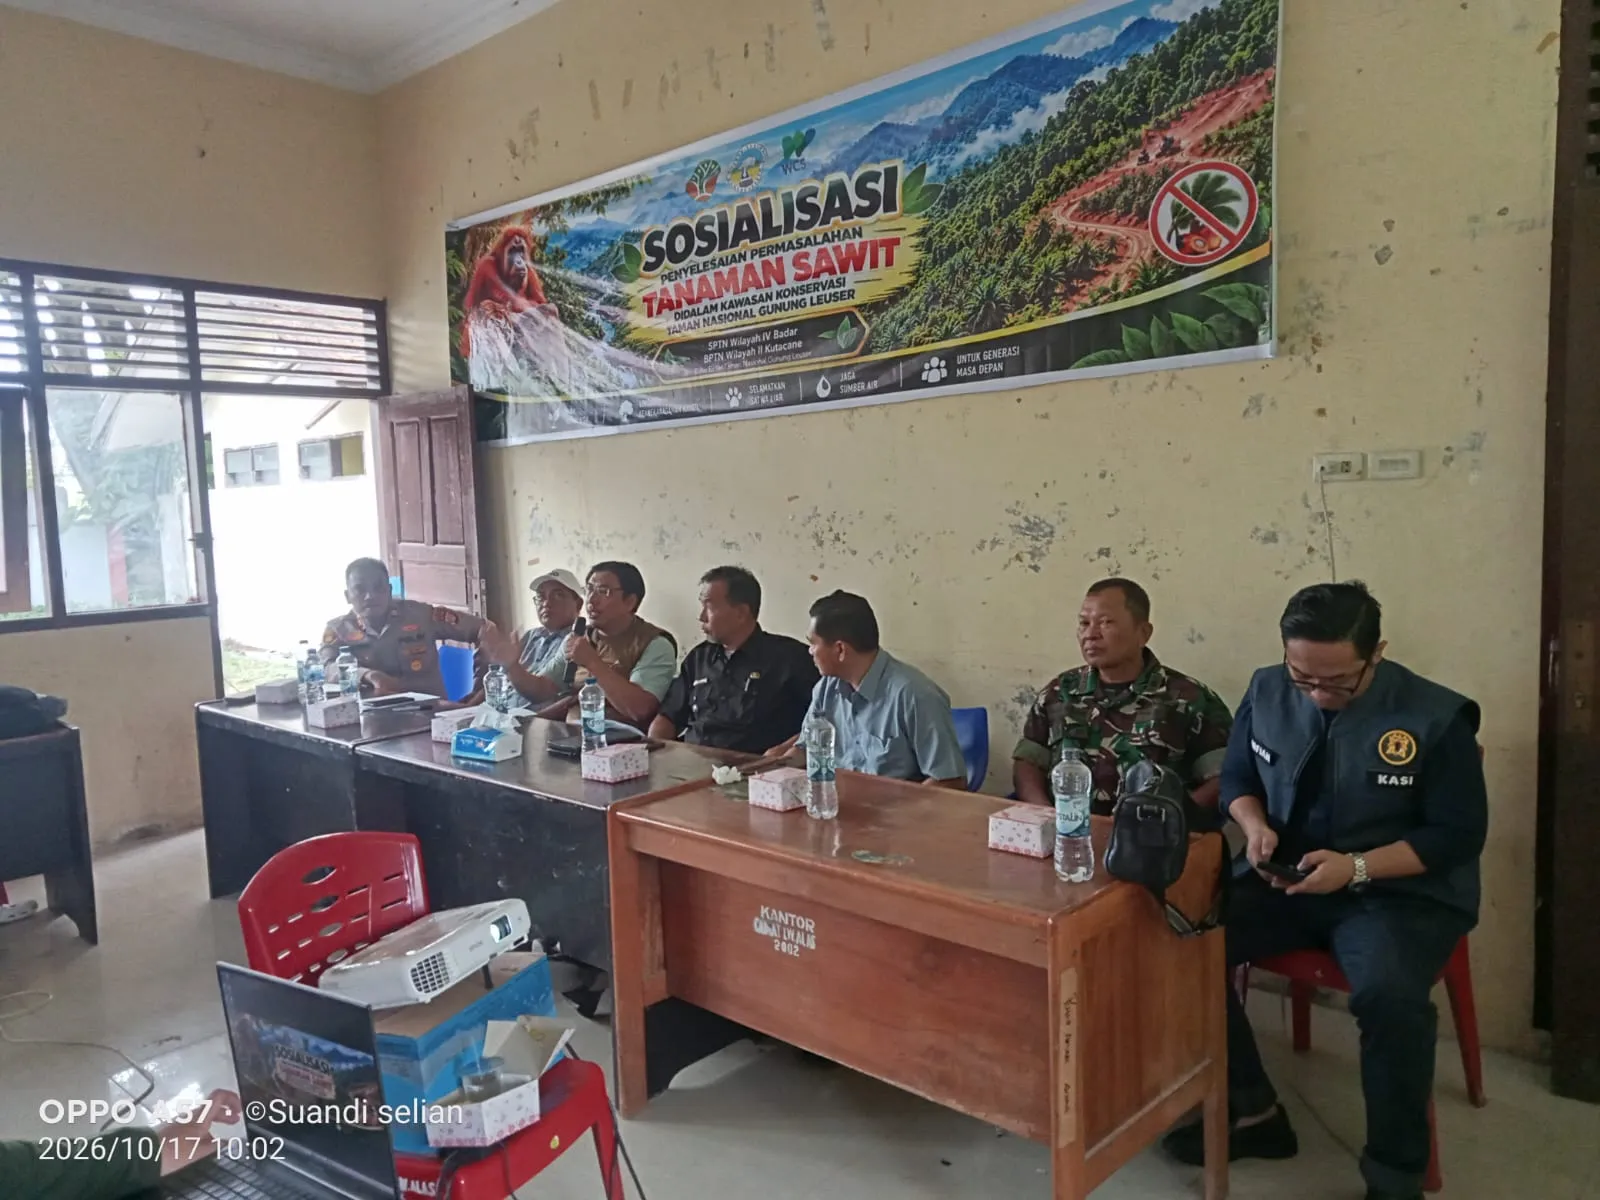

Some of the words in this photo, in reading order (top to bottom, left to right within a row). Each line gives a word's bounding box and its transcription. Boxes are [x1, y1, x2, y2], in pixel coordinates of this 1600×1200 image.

[782, 157, 807, 176] WCS
[642, 165, 899, 273] SOSIALISASI
[660, 251, 748, 284] PENYELESAIAN
[750, 226, 863, 260] PERMASALAHAN
[642, 255, 786, 319] TANAMAN
[792, 237, 901, 282] SAWIT
[674, 303, 718, 321] DIDALAM
[720, 291, 773, 311] KAWASAN
[775, 277, 846, 300] KONSERVASI
[667, 320, 701, 335] TAMAN
[703, 309, 756, 328] NASIONAL
[759, 299, 807, 317] GUNUNG
[809, 289, 856, 307] LEUSER
[708, 339, 728, 351] SPTN
[730, 333, 761, 348] Wilayah
[762, 331, 771, 341] IV
[773, 327, 798, 340] Badar
[725, 346, 756, 360] Wilayah
[764, 340, 803, 353] Kutacane
[956, 353, 981, 365] UNTUK
[982, 346, 1020, 361] GENERASI
[956, 366, 977, 378] MASA
[978, 362, 1004, 375] DEPAN
[839, 381, 866, 394] SUMBER
[866, 379, 879, 390] AIR
[1377, 773, 1414, 786] KASI
[760, 904, 816, 934] KANTOR
